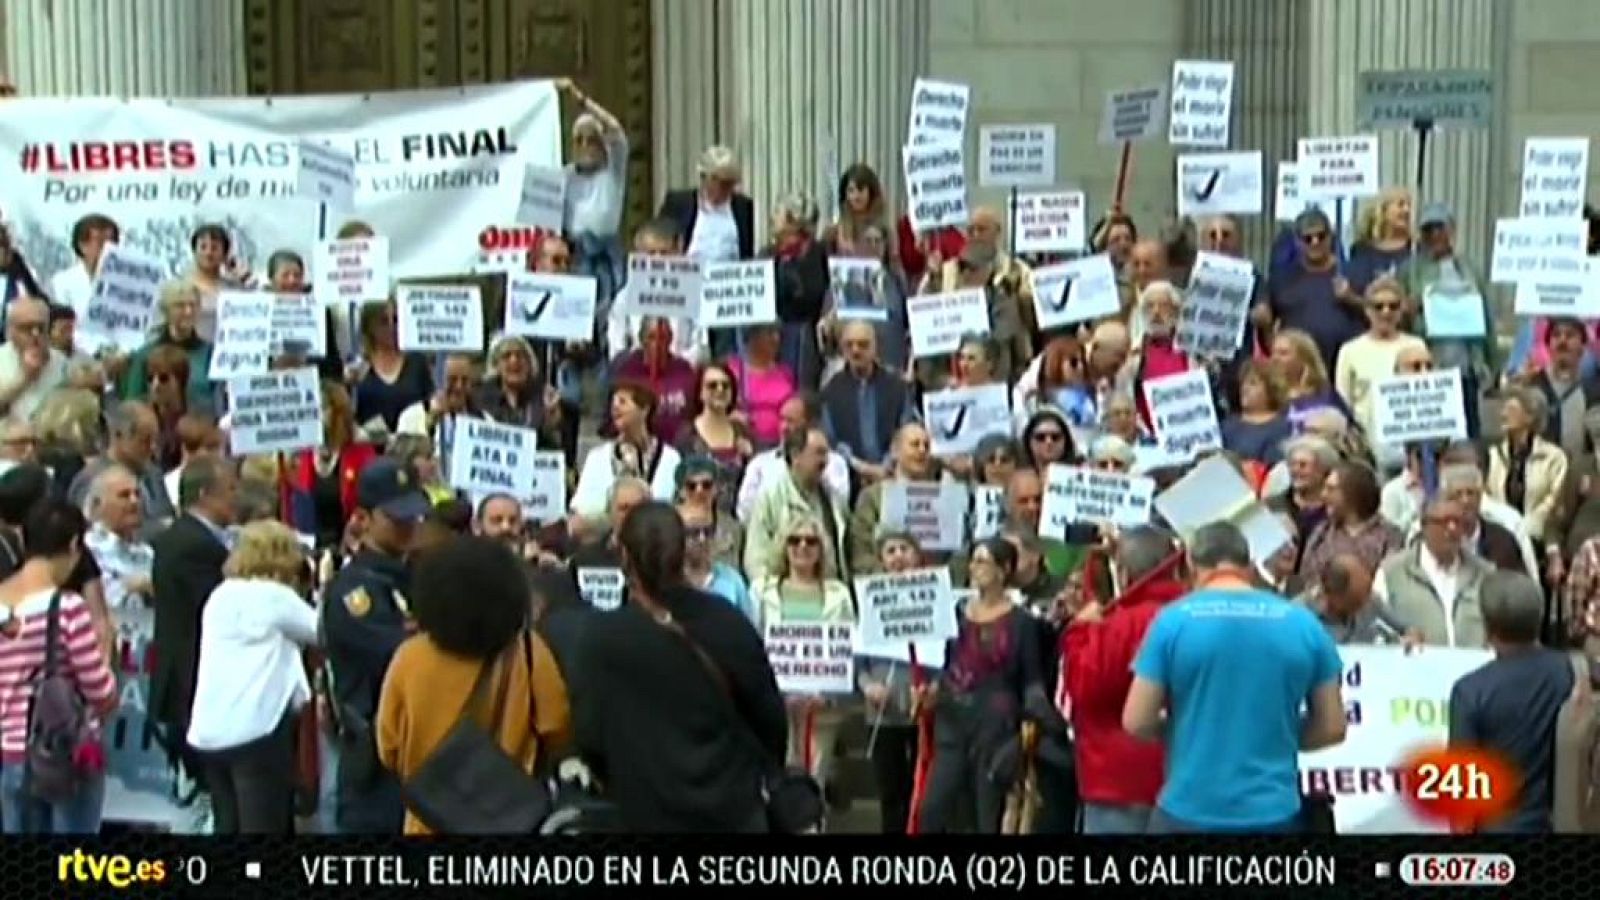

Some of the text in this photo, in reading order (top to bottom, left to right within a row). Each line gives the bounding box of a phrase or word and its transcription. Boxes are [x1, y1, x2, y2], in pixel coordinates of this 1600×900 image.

[20, 127, 517, 172] #LIBRES HAS EL FINAL
[44, 180, 97, 203] Por
[107, 181, 158, 201] una
[170, 177, 207, 205] ley
[216, 175, 250, 199] de
[371, 168, 501, 191] voluntaria
[470, 466, 514, 488] FINAL
[769, 625, 850, 639] MORIR EN
[802, 644, 823, 657] ES
[829, 643, 852, 657] UN
